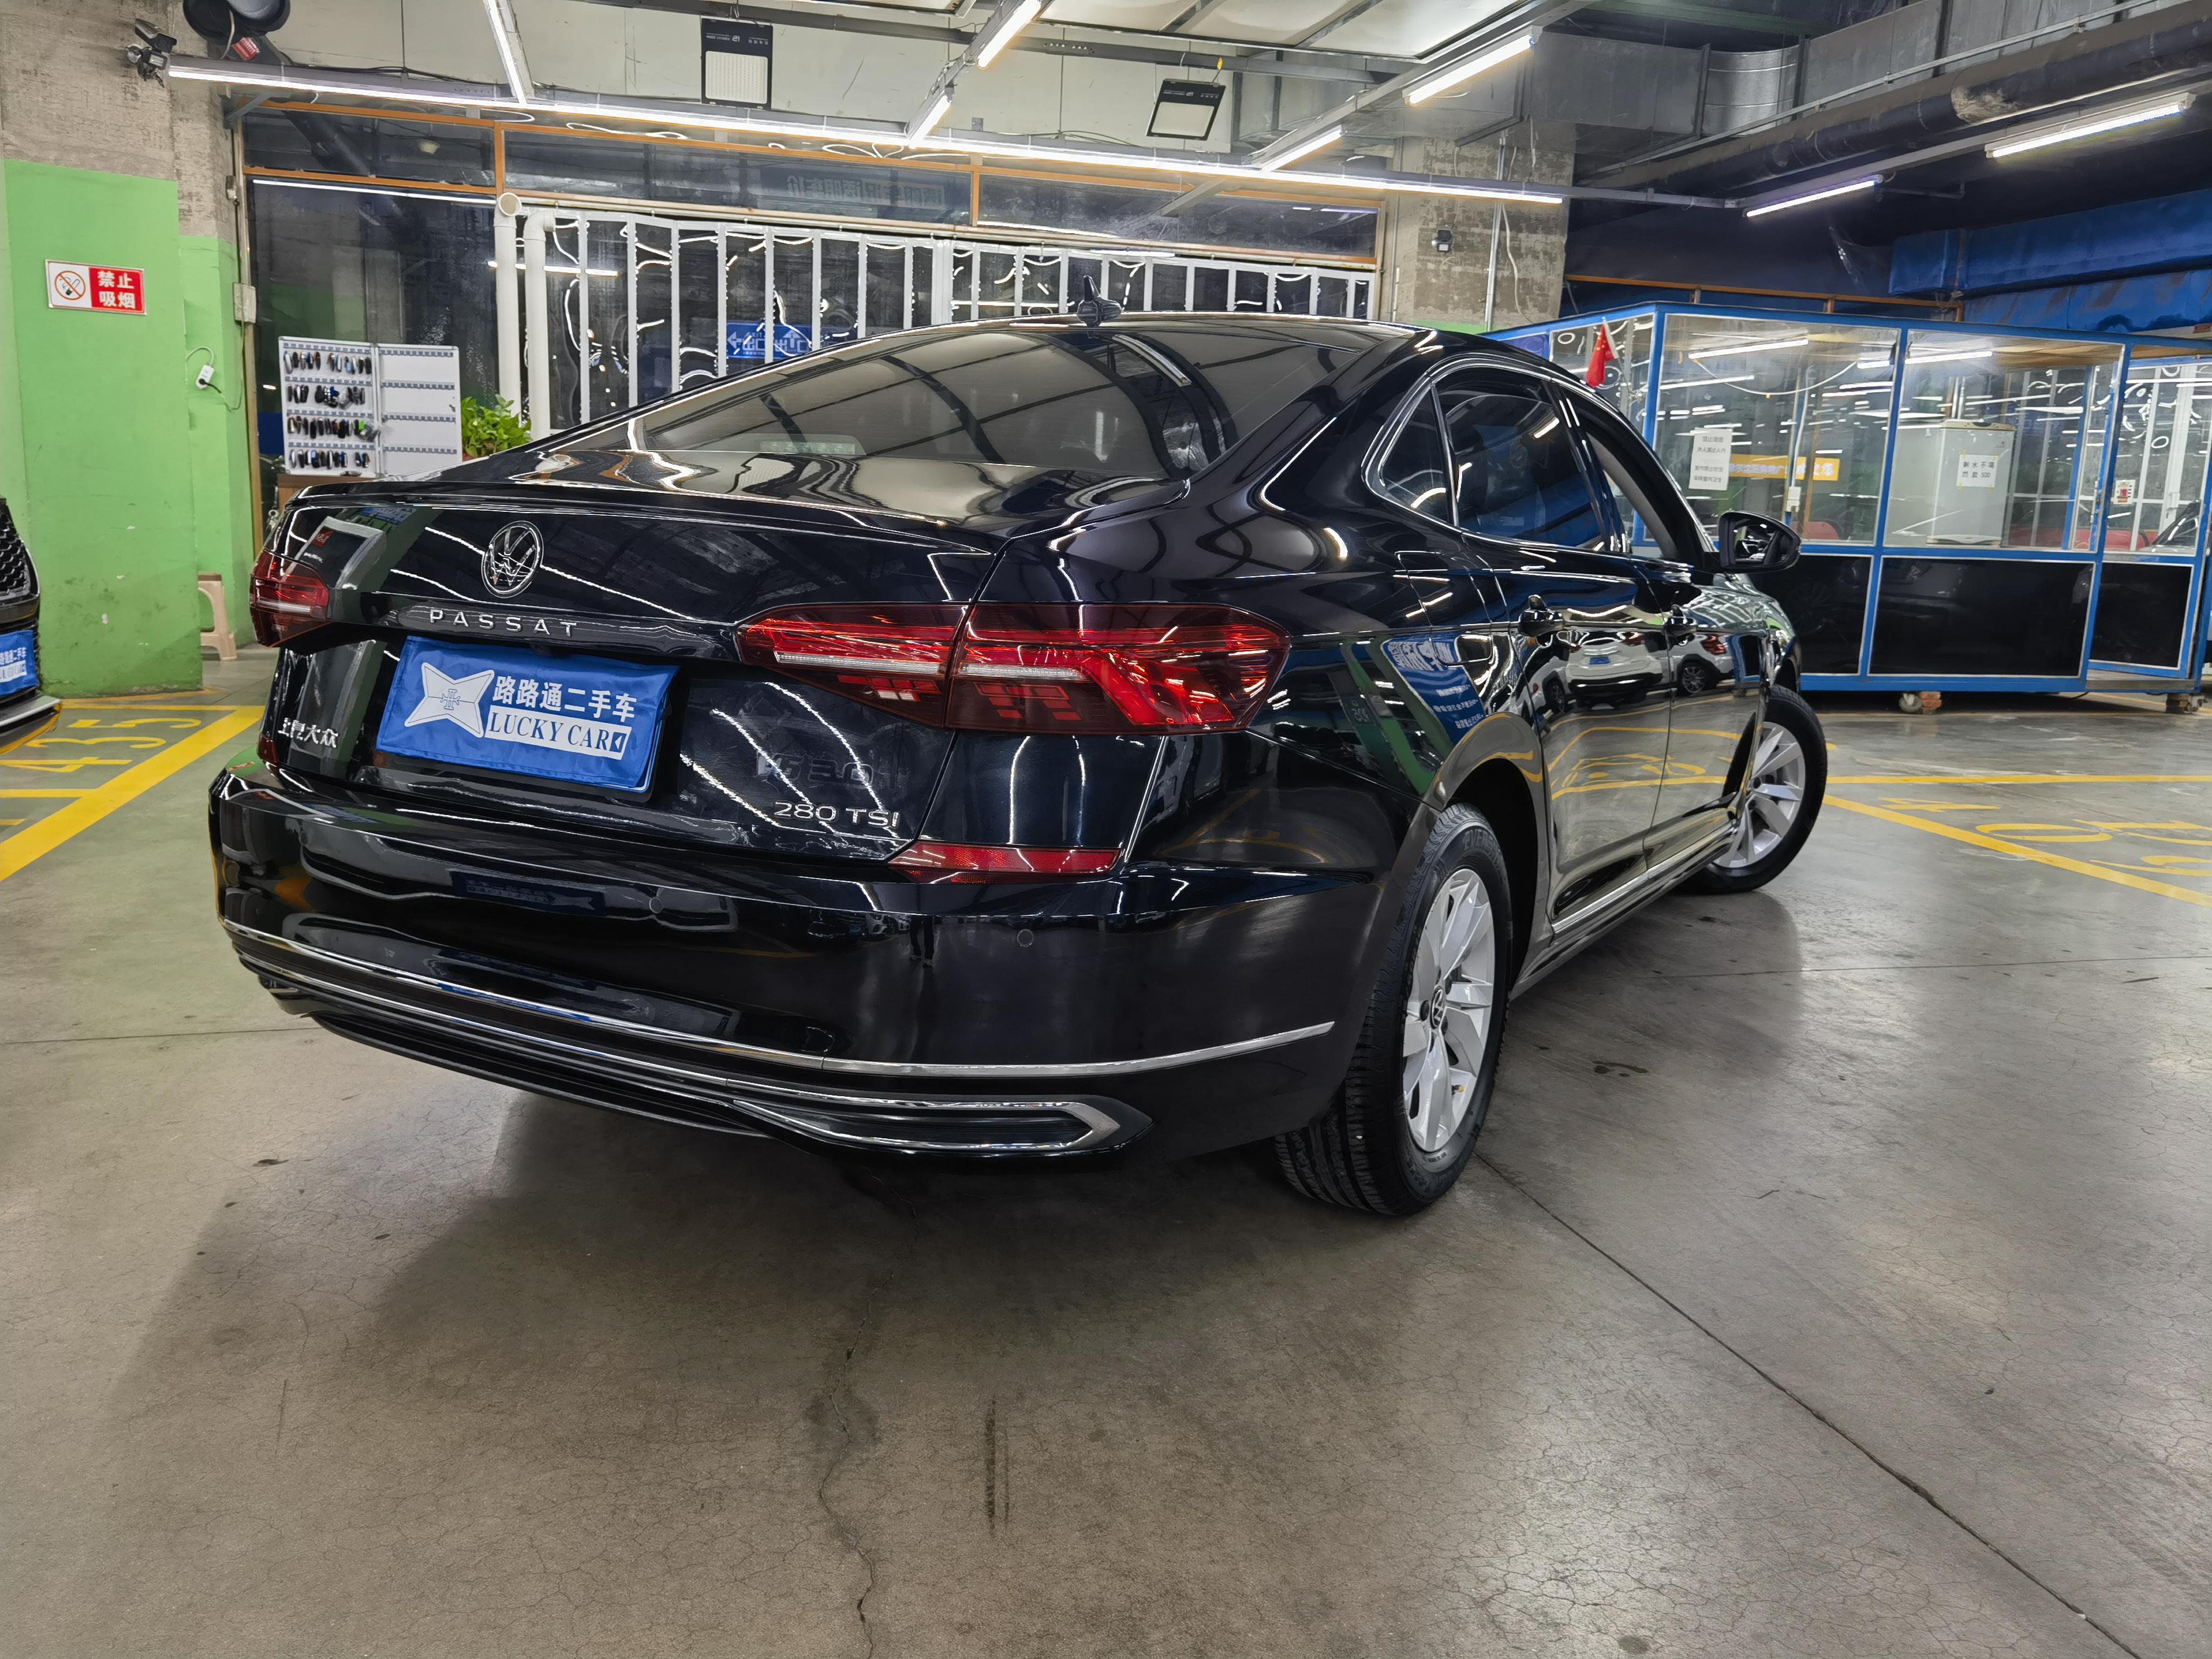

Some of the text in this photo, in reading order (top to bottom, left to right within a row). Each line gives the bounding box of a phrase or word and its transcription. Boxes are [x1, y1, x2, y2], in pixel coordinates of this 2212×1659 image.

[97, 271, 134, 289] 禁止
[99, 291, 136, 309] 吸烟
[430, 609, 577, 637] PASSAT
[492, 676, 637, 723] 路路通二手车
[489, 712, 610, 751] LUCKY CAR
[774, 801, 900, 828] 280 TSI
